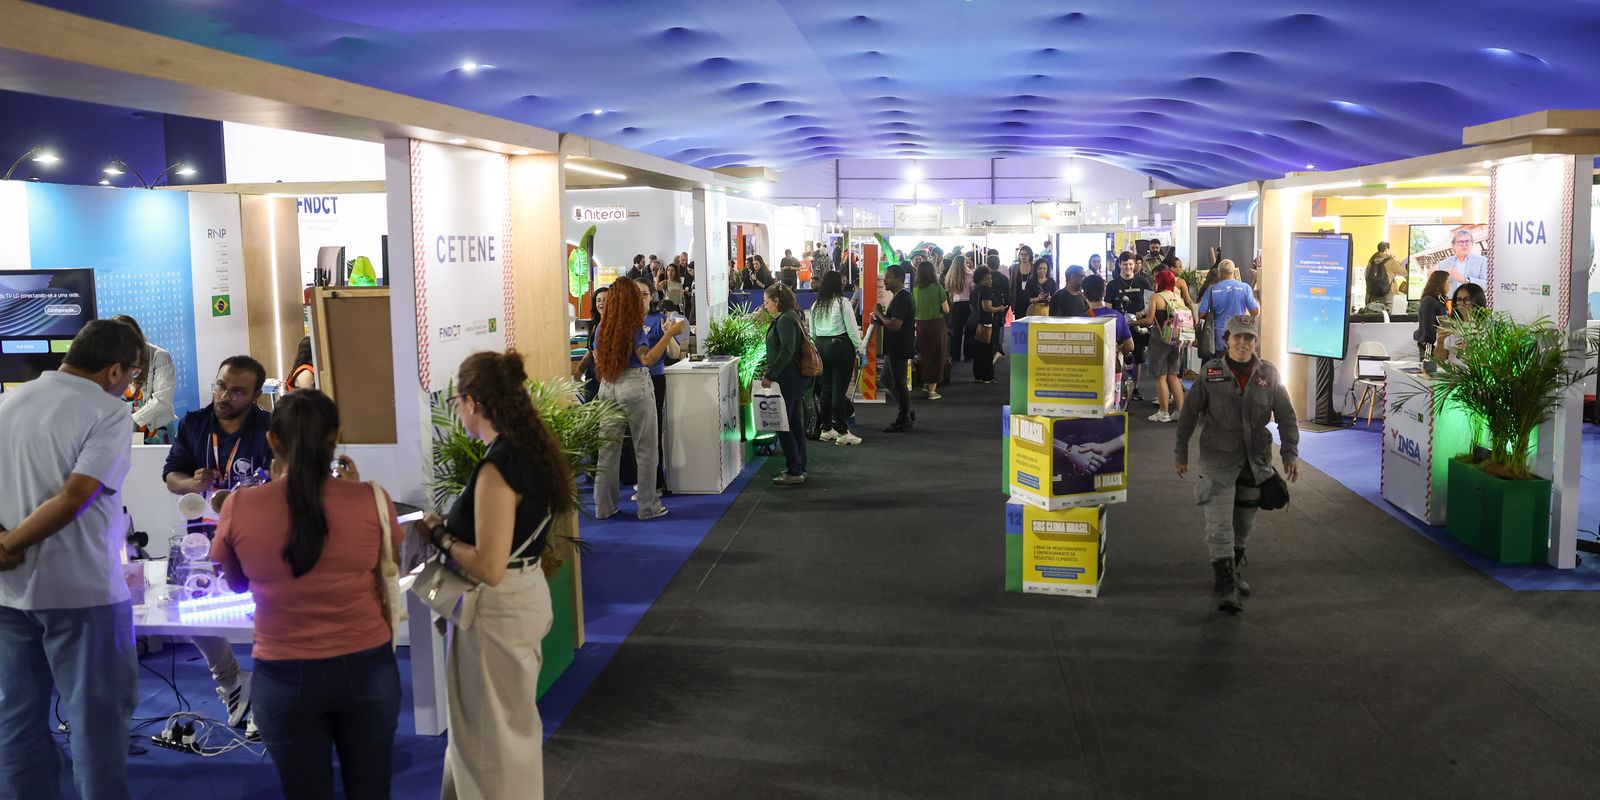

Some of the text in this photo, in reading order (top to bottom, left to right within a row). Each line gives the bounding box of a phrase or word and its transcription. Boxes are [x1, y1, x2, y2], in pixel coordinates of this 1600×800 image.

[297, 197, 338, 214] FNDCT
[1508, 220, 1547, 244] INSA
[436, 235, 495, 264] CETENE
[1012, 331, 1027, 345] 10
[1020, 418, 1044, 444] BRASIL
[1398, 433, 1420, 461] INSA
[1102, 473, 1122, 487] BRASIL
[1007, 512, 1023, 525] 12
[1033, 521, 1089, 533] SOS CLIMA BRASIL
